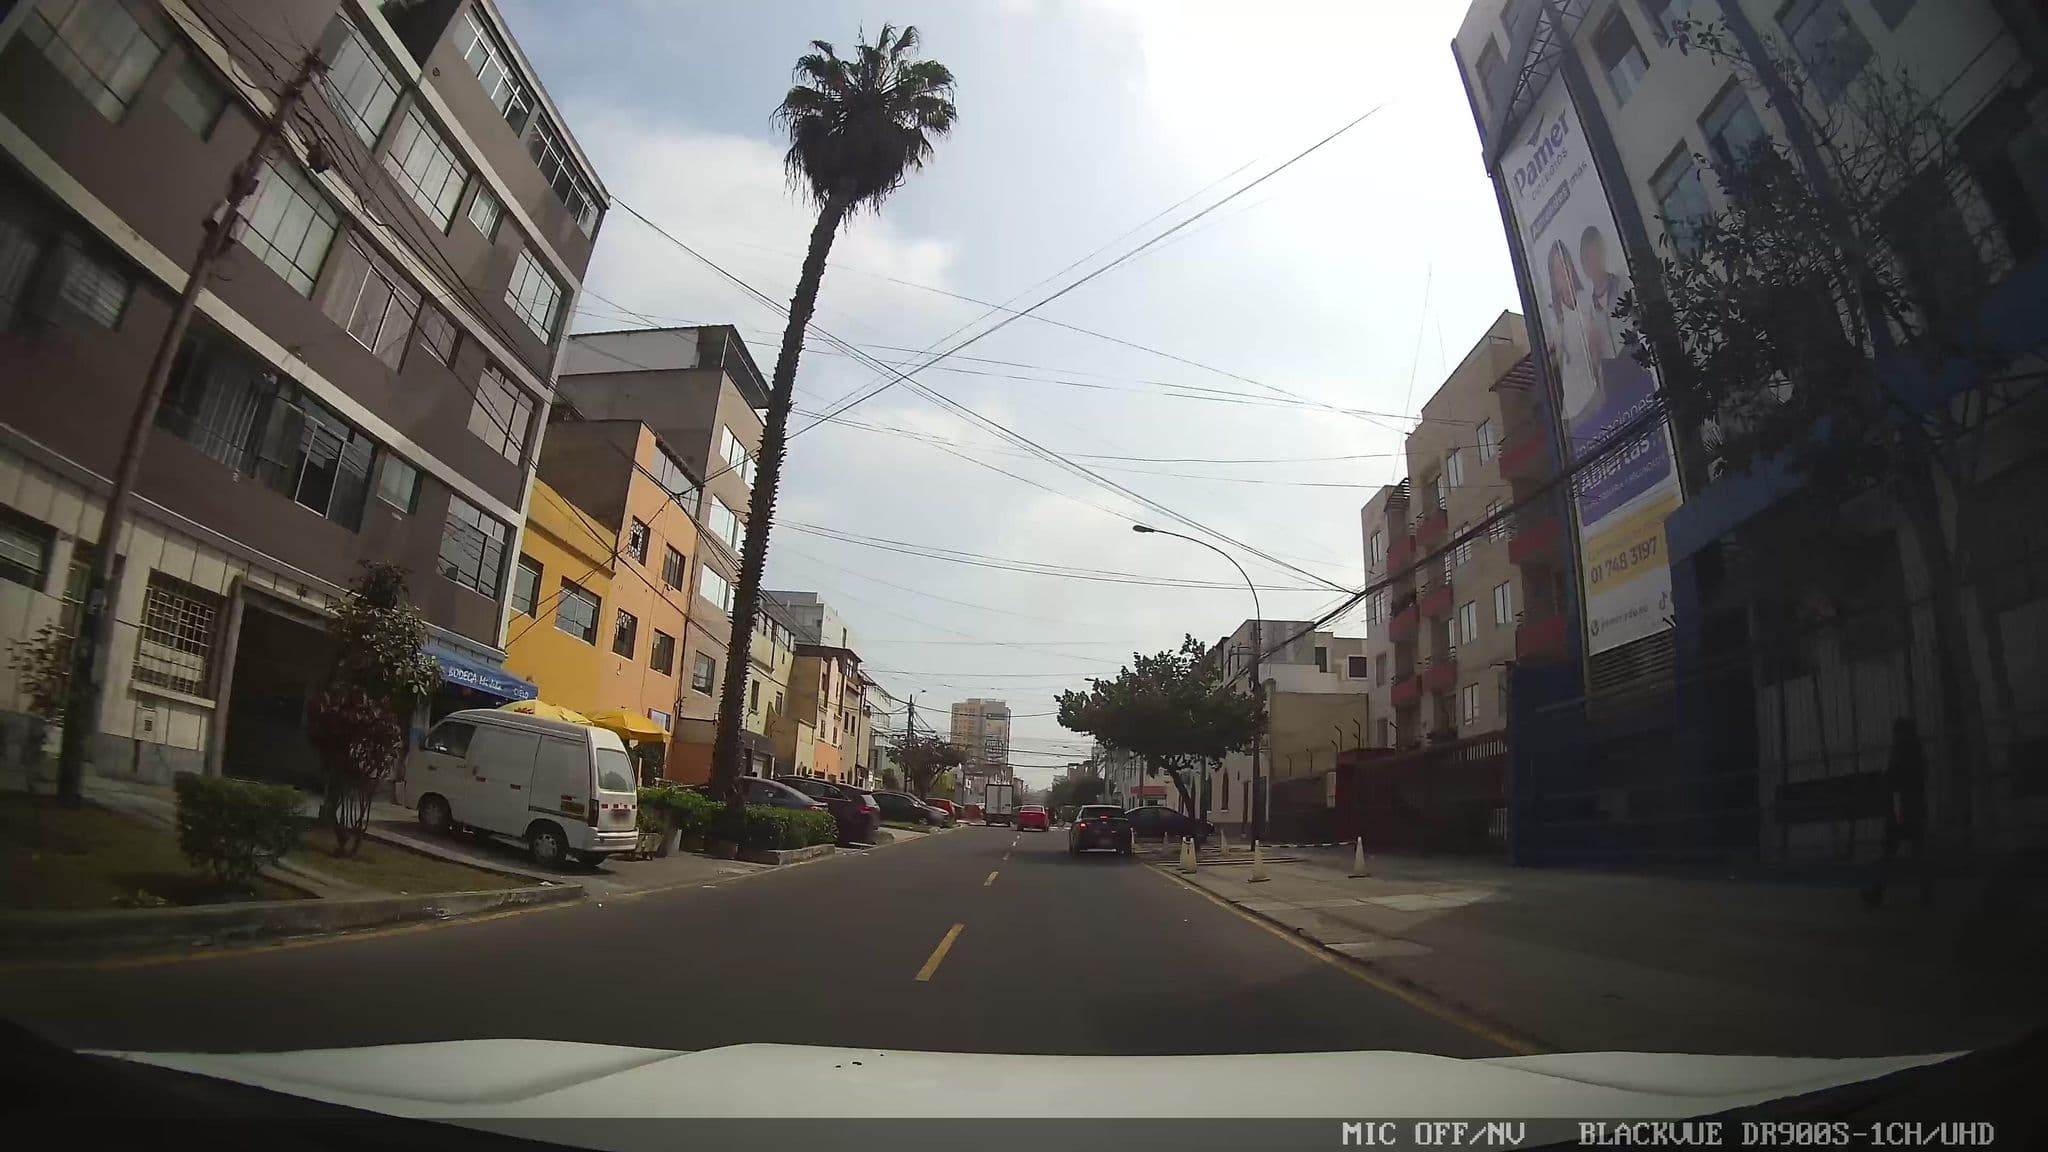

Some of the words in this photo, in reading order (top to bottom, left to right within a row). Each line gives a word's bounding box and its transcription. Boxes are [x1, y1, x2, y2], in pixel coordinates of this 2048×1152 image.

[1513, 108, 1569, 197] Pamer
[1590, 566, 1603, 584] 01
[1605, 551, 1628, 577] 748
[1630, 536, 1657, 566] 3197
[448, 666, 477, 684] BODEGA
